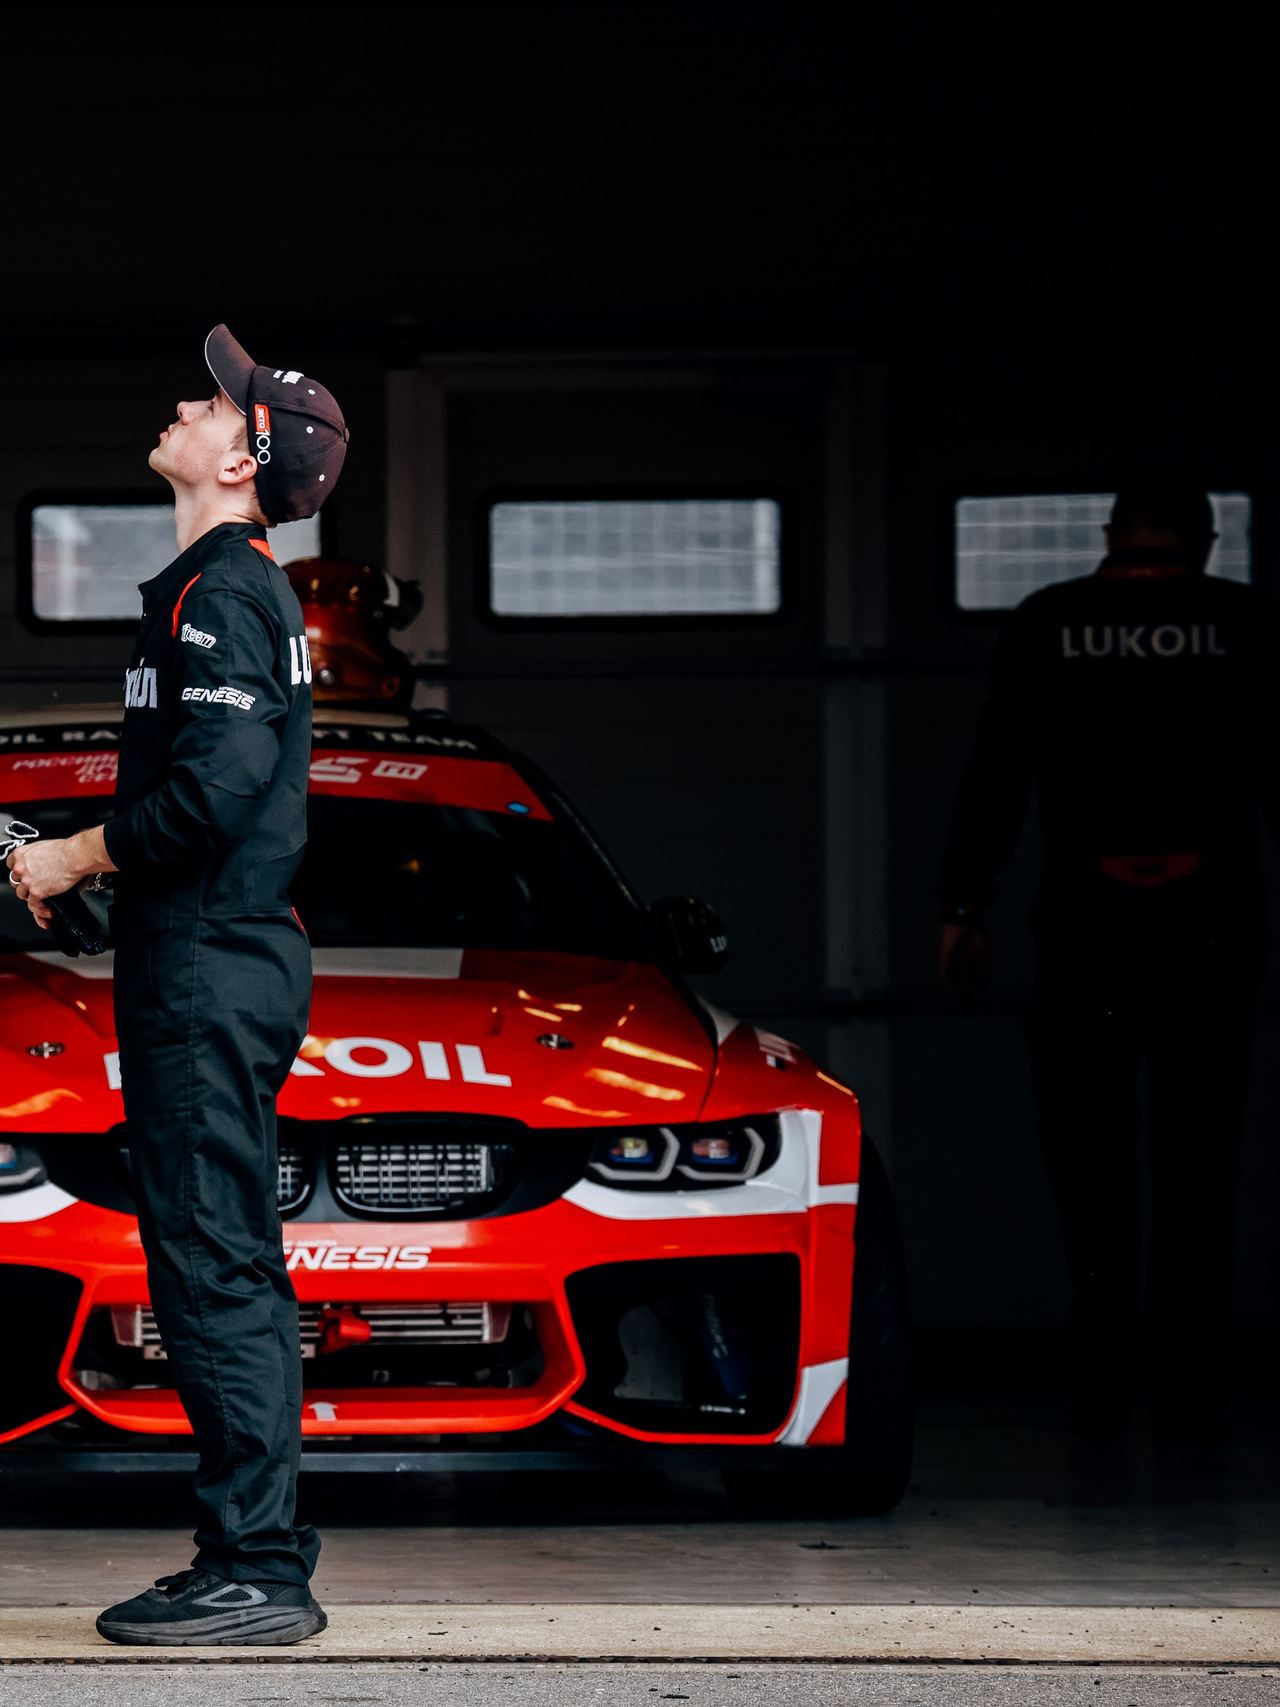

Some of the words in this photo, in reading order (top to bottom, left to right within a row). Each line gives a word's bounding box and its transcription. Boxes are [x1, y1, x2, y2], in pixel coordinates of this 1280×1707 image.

[255, 427, 272, 465] 100
[1060, 622, 1229, 661] LUKOIL
[181, 687, 254, 712] GENESIS
[61, 727, 120, 743] RA
[366, 731, 481, 750] TEAM
